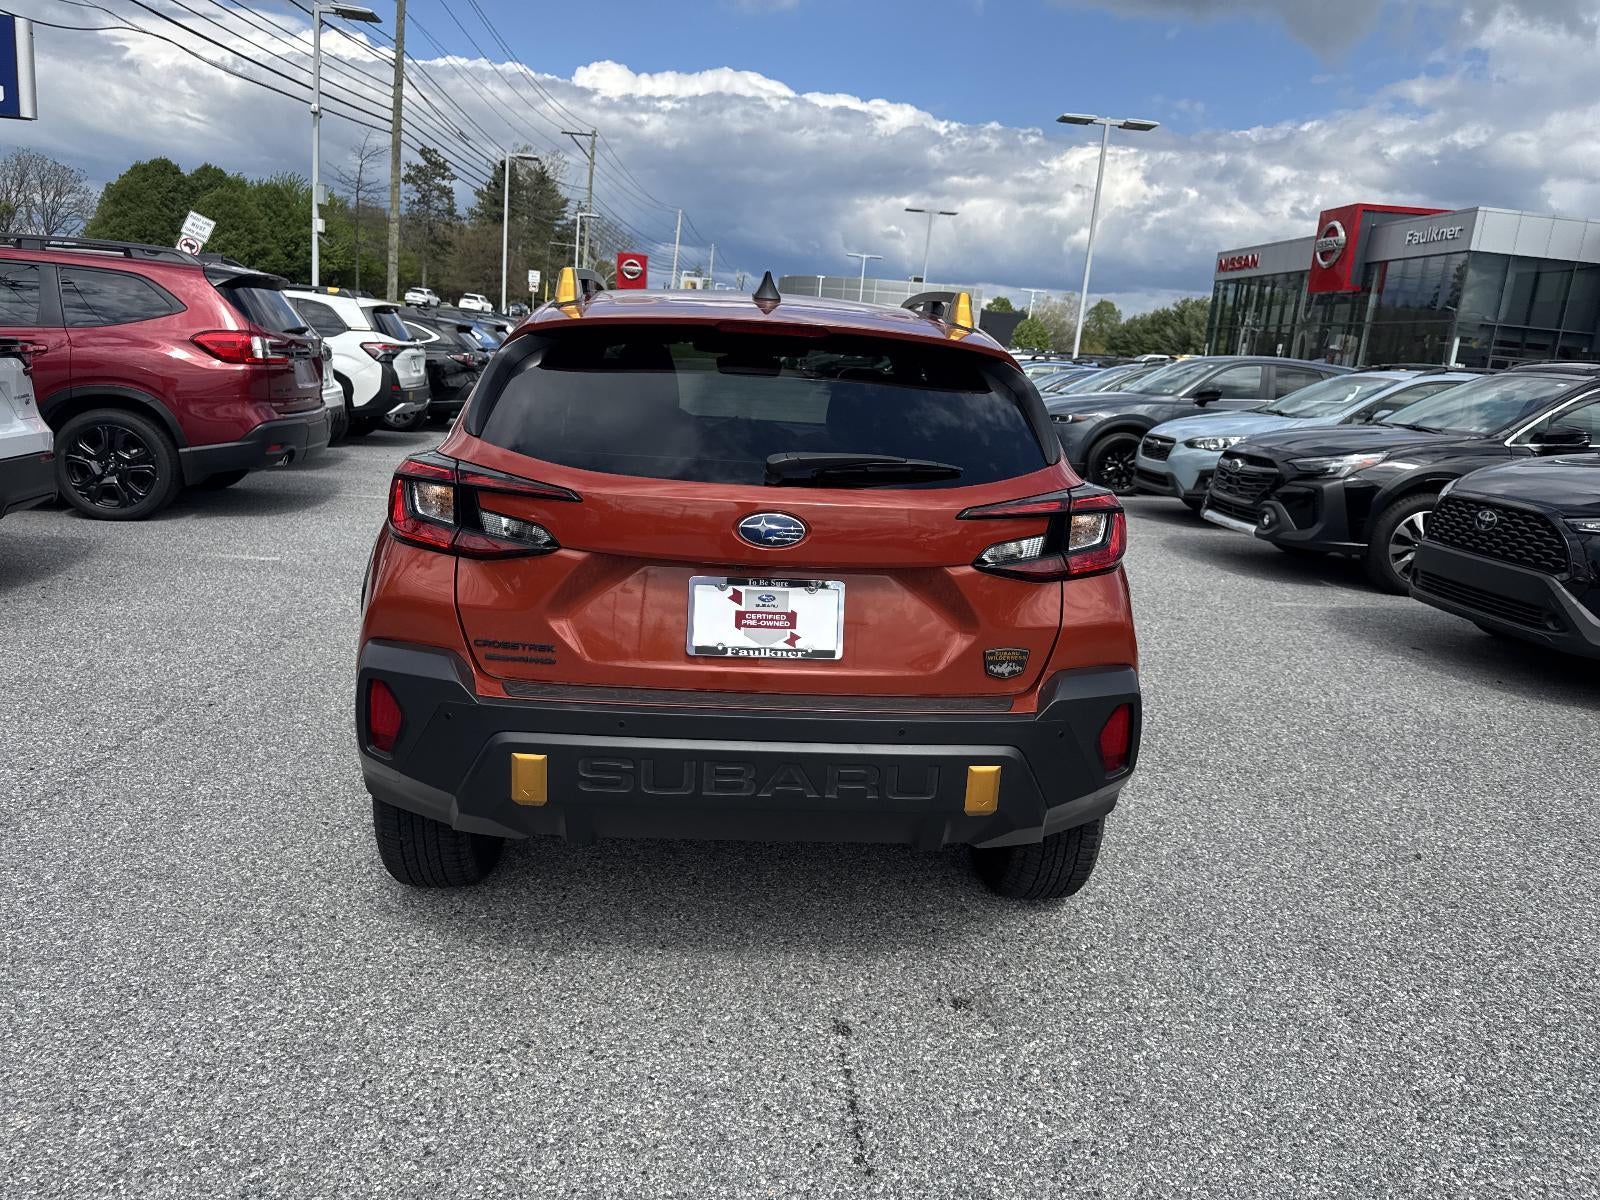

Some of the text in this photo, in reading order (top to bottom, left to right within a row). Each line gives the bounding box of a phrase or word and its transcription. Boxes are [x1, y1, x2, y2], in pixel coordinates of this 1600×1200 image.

[1405, 225, 1463, 245] Faulkner
[1218, 253, 1259, 273] NISSAN
[741, 619, 790, 627] PRE-OWNED
[745, 613, 786, 621] CERTIFIED
[727, 647, 806, 658] Faulkner
[577, 756, 942, 800] SUBARU
